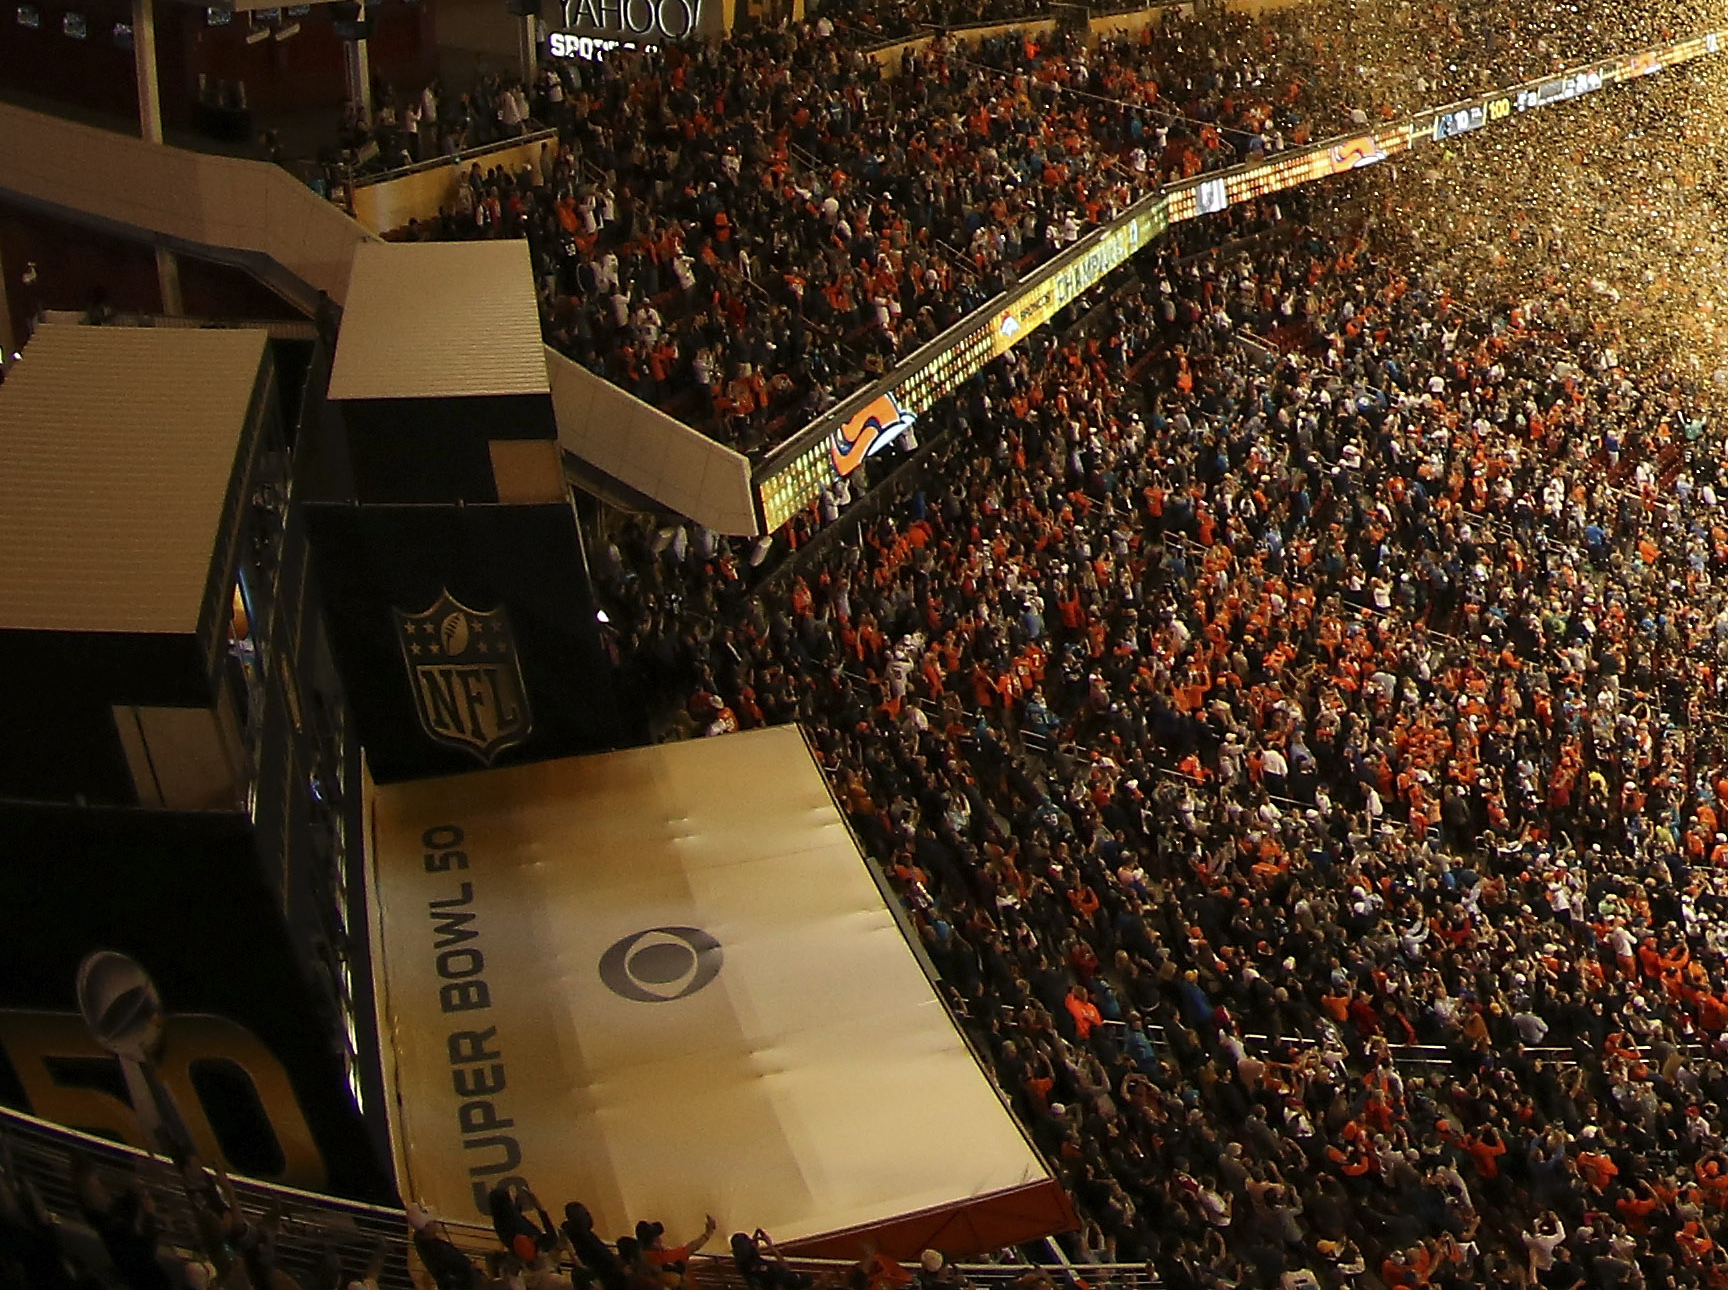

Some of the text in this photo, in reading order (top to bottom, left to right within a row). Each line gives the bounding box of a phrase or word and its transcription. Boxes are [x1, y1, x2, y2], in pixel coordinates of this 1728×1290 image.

[421, 665, 519, 742] NFL
[421, 823, 532, 1218] SUPER BOWL 50
